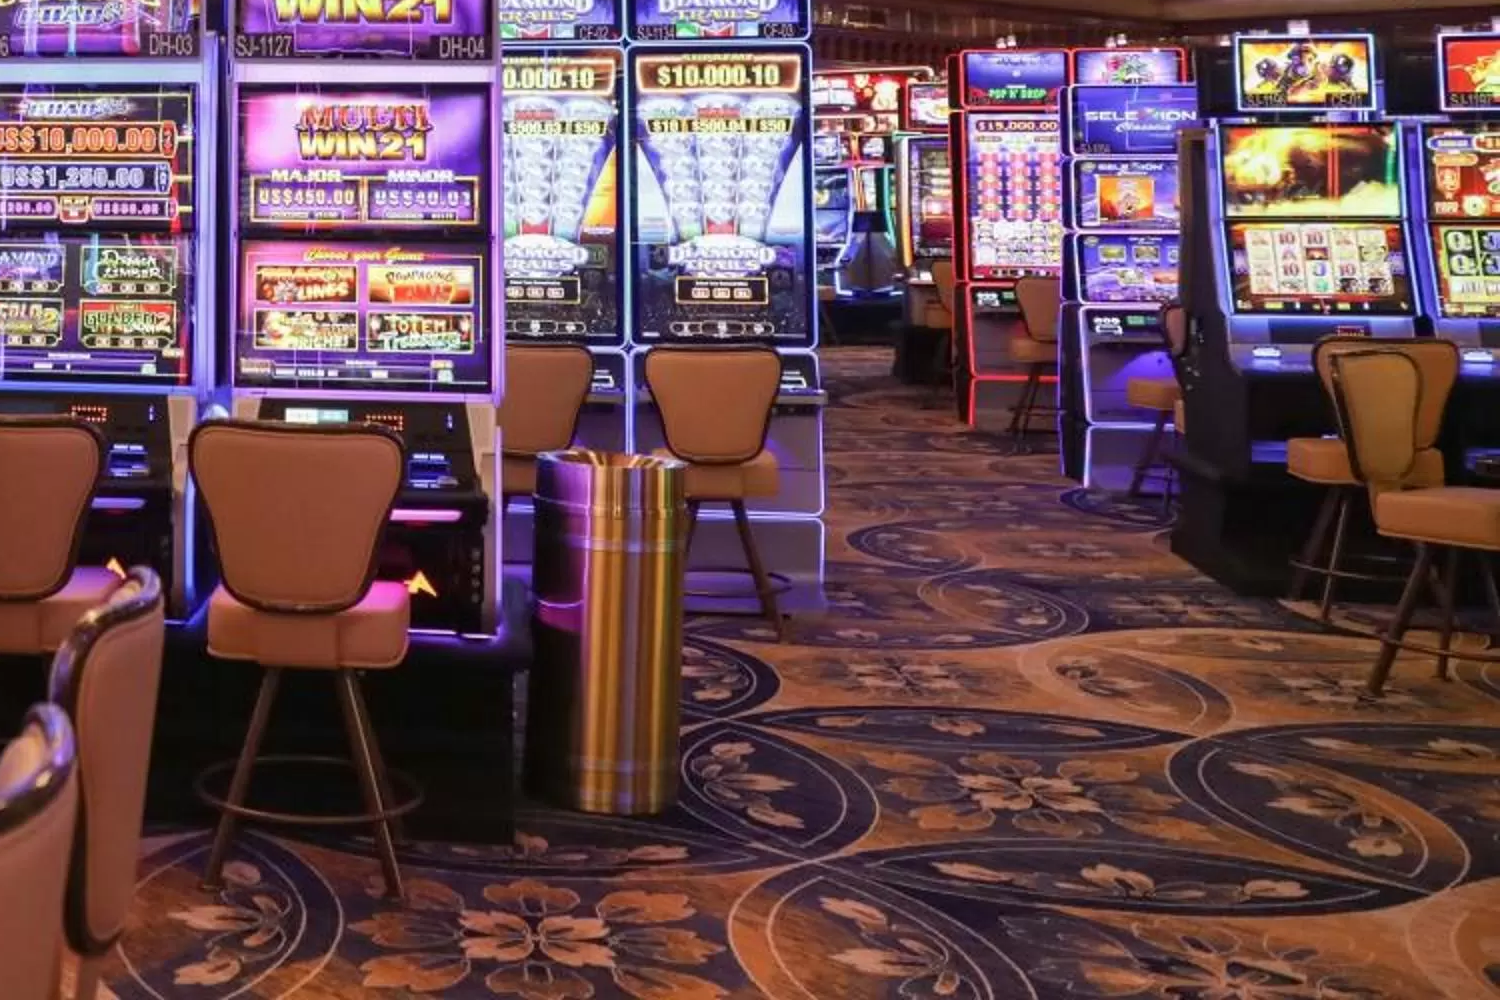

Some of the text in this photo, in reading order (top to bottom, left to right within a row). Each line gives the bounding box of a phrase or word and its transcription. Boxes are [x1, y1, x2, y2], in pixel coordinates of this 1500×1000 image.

[674, 8, 760, 22] TRAILS
[149, 33, 193, 55] DH-03
[236, 36, 292, 57] SJ-1127
[439, 38, 485, 58] DH-04
[294, 103, 434, 131] MULTI
[299, 131, 426, 161] WIN21
[271, 169, 342, 183] MAJOR
[387, 169, 455, 183] MINOR
[505, 245, 588, 265] AMOND
[668, 245, 776, 265] DIAMOND
